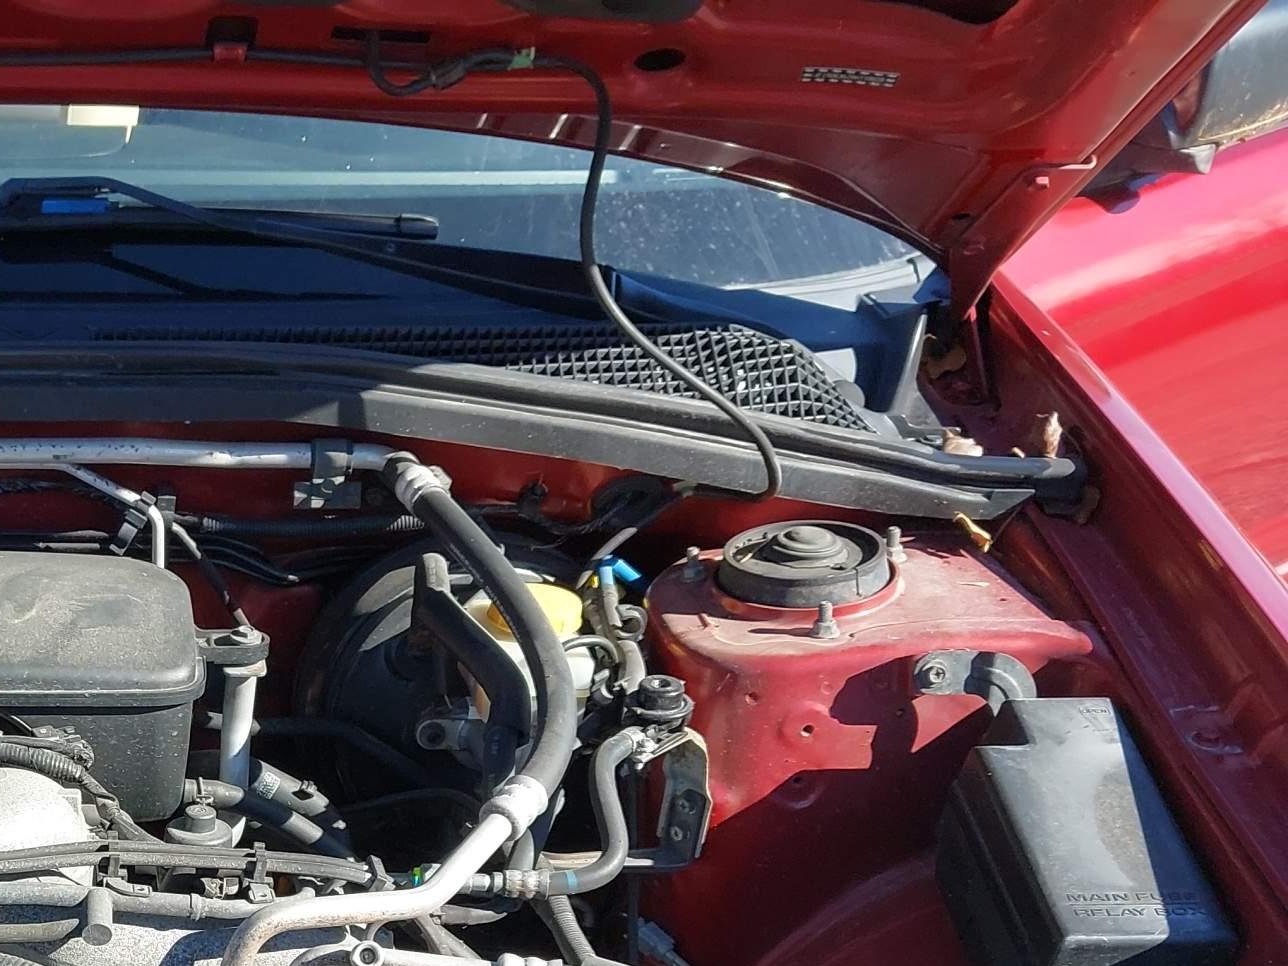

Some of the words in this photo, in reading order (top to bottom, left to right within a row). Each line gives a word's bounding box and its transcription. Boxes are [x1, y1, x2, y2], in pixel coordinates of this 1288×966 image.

[1066, 892, 1129, 902] MAIN
[1135, 892, 1197, 902] FUSE
[1073, 907, 1146, 917] RELAY
[1155, 907, 1208, 917] BOX
